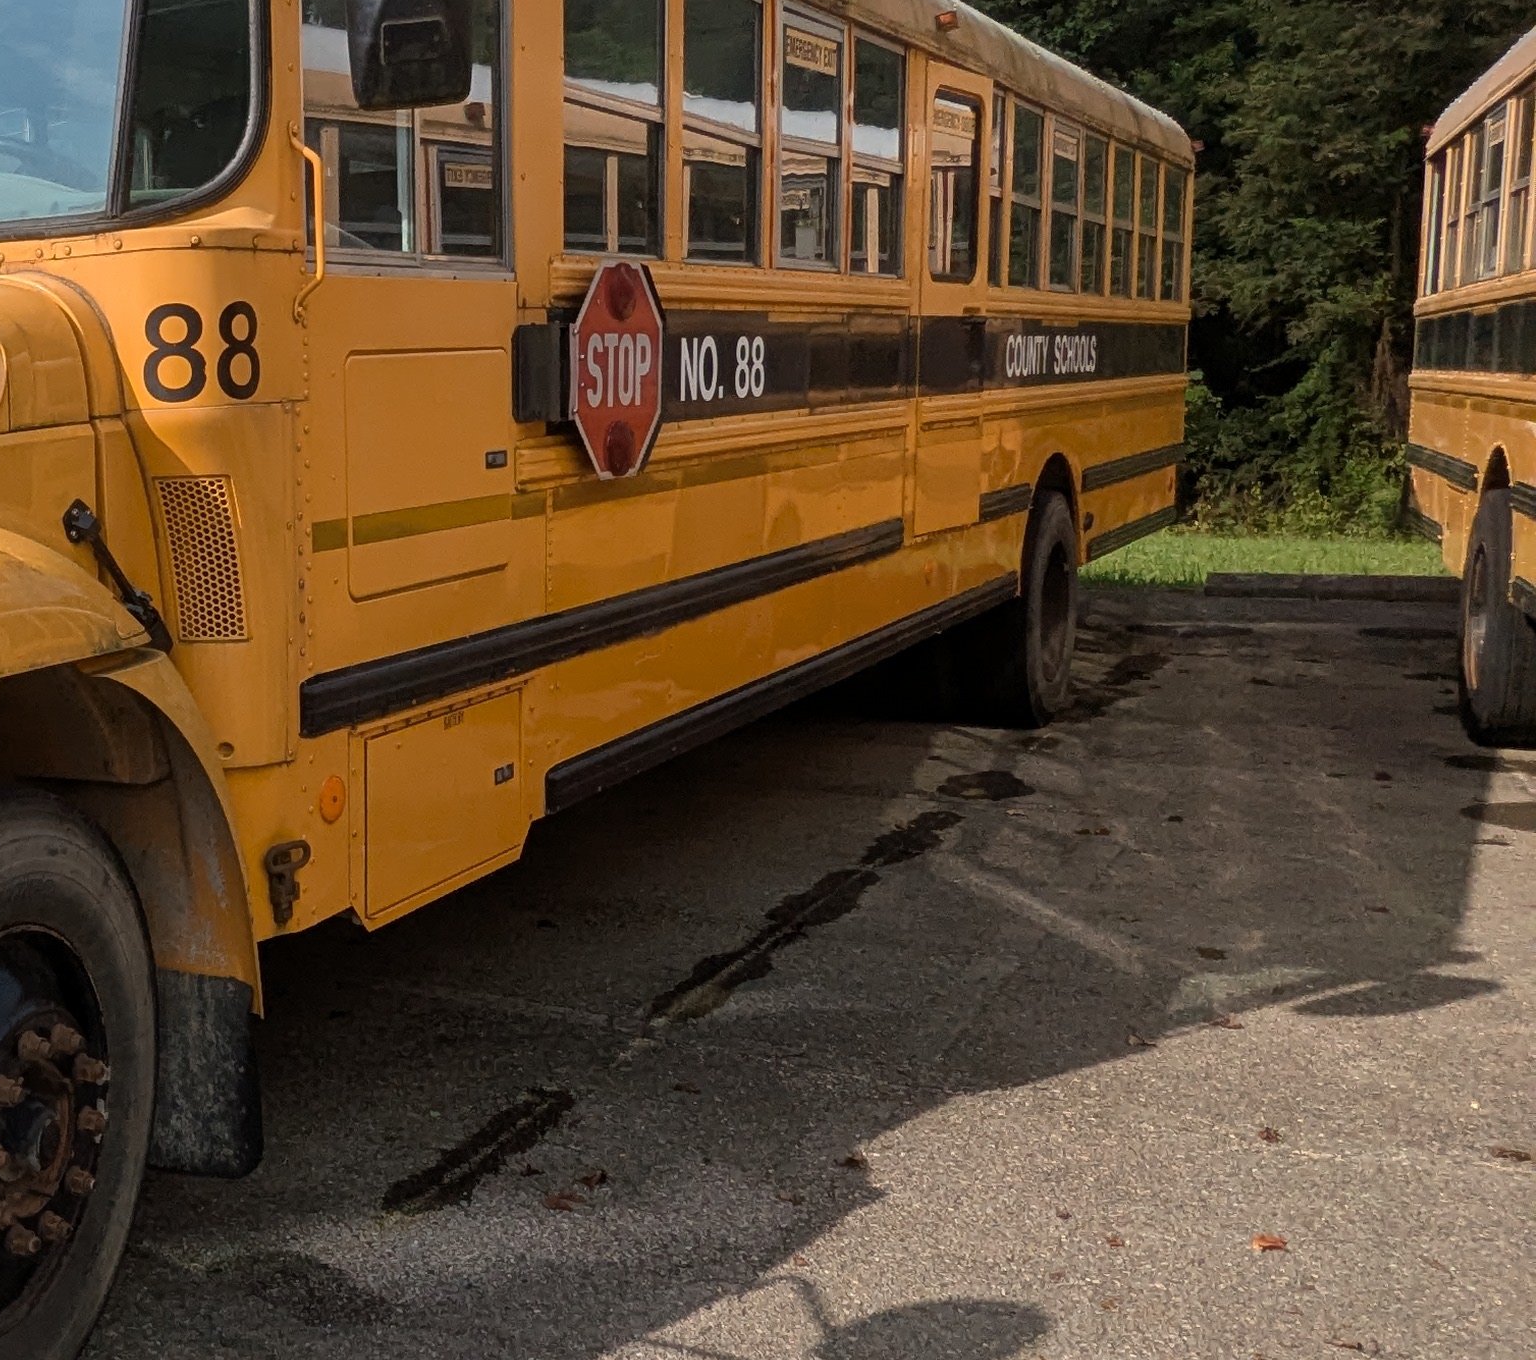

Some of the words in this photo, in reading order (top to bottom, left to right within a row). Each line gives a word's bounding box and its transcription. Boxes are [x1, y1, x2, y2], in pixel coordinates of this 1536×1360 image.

[143, 301, 260, 403] 88
[586, 333, 652, 407] STOP
[680, 335, 724, 402] NO.
[734, 335, 764, 398] 88
[1006, 335, 1049, 377] COUNTY
[1054, 335, 1096, 374] SCHOOLS
